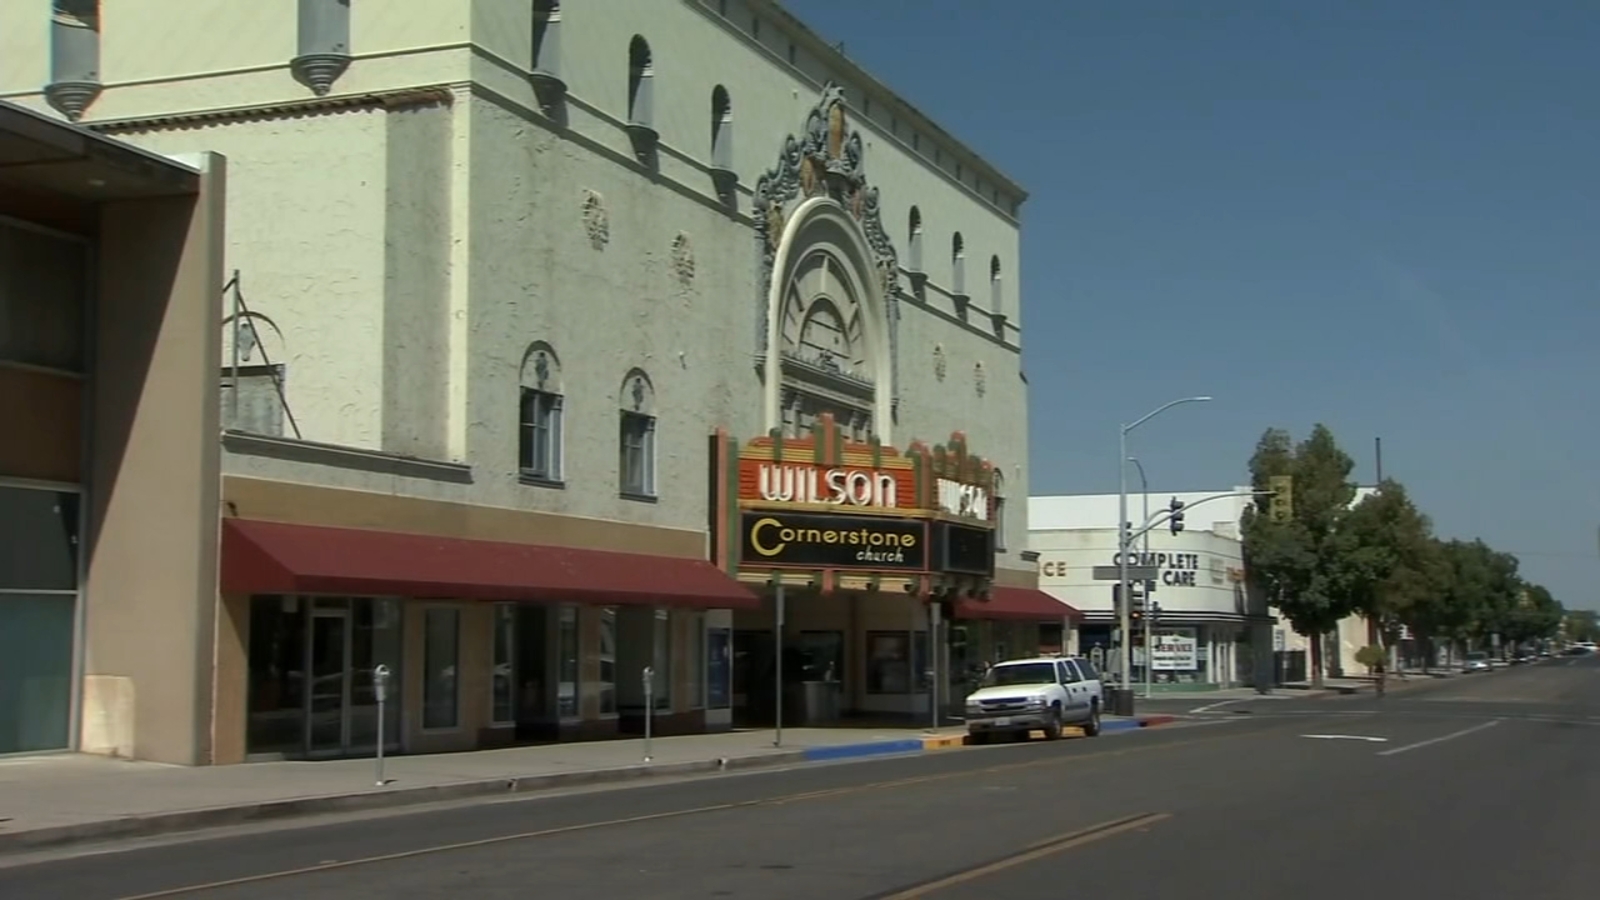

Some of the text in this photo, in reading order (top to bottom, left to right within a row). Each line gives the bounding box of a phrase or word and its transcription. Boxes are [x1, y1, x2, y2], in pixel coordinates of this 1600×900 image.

[759, 463, 896, 508] WILSON
[751, 518, 916, 556] Cornerstone
[856, 545, 905, 563] church
[1163, 570, 1197, 587] CARE
